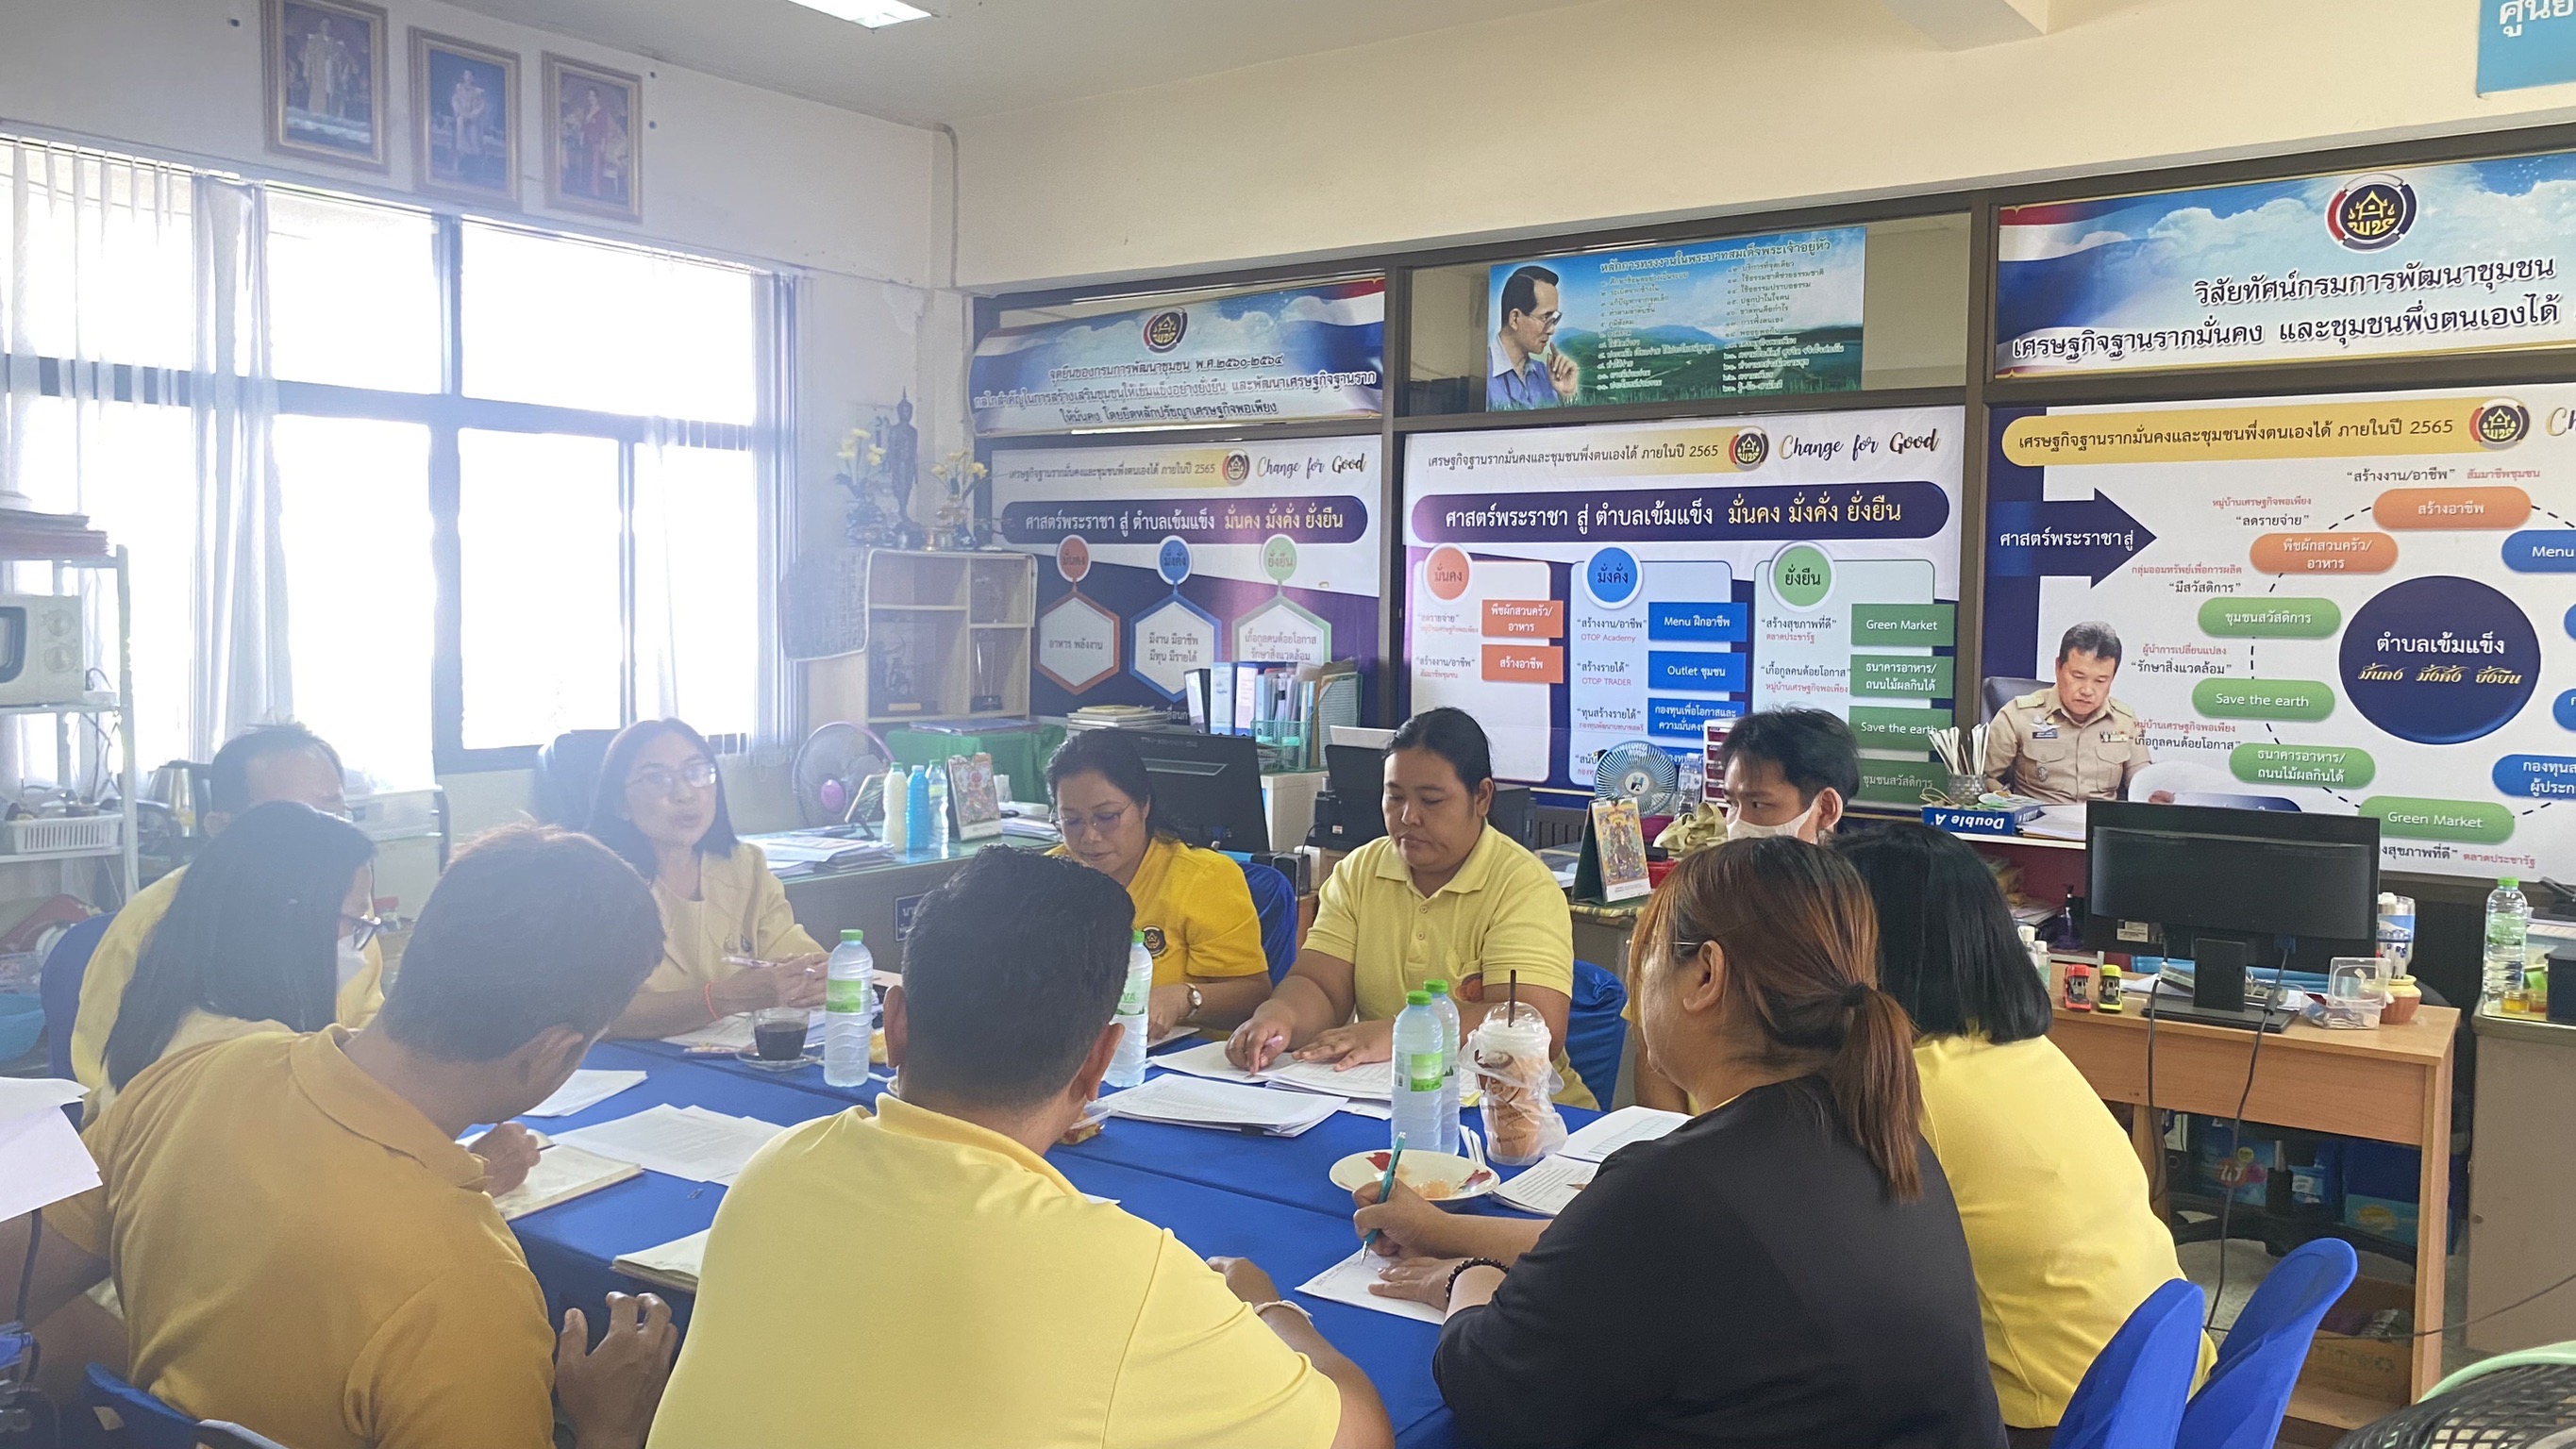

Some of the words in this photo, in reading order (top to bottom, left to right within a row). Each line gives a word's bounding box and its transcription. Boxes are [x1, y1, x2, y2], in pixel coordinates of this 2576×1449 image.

[1600, 238, 1831, 273] หลักการทรงงานในพระบาทสมเด็จพระเจ้าอยู่หัว
[2194, 258, 2555, 305] วิสัยทัศน์กรมการพัฒนาชุมชน
[2014, 318, 2264, 361] เศรษฐกิจฐานรากมั่นคง
[2279, 293, 2560, 349] และชุมชนพึ่งตนเองได้
[1231, 369, 1377, 392] และพัฒนาเศรษฐกิจฐานราก
[2017, 419, 2332, 453] เศรษฐกิจฐานรากมั่นคงและชุมชนพึ่งตนเองได้
[2337, 416, 2402, 438] ภายในปี
[2410, 418, 2453, 435] 2565
[1778, 437, 1844, 461] Change
[1852, 434, 1879, 461] for
[1889, 428, 1940, 455] Good
[1428, 443, 1638, 471] เศรษฐกิจฐานรากมั่นคงและชุมชนพึ่งตนเองได้
[1641, 442, 1686, 459] ภายในปี
[1689, 444, 1719, 458] 2565
[1194, 463, 1216, 475] 2565
[1257, 456, 1301, 479] Change
[1306, 457, 1325, 480] for
[1331, 452, 1366, 475] Good
[2347, 466, 2456, 483] “สร้างงาน/อาชีพ”
[1445, 503, 1569, 528] ศาสตร์พระราชา
[1577, 503, 1589, 535] สู่
[1596, 500, 1714, 528] ตำบลเข้มแข็ง
[1728, 496, 1781, 525] มั่นคง
[1788, 491, 1839, 523] มั่งคั่ง
[1848, 490, 1901, 522] ยั่งยืน
[2417, 500, 2484, 516] สร้างอาชีพ
[1025, 508, 1115, 531] ศาสตร์พระราชา
[1133, 507, 1215, 532] ตำบลเข้มแข็ง
[1223, 503, 1261, 530] มั่นคง
[1265, 502, 1300, 529] มั่งคั่ง
[1305, 502, 1344, 529] ยั่งยืน
[2235, 513, 2310, 526] “ลดรายจ่าย”
[2283, 537, 2372, 554] พืชผักสวนครัว/
[2532, 546, 2575, 558] Menu
[2307, 556, 2345, 570] อาหาร
[1434, 563, 1464, 583] มั่นคง
[1597, 563, 1629, 585] มั่งคั่ง
[1784, 564, 1821, 587] ยั่งยืน
[2168, 579, 2242, 594] “มีสวัสดิการ”
[1491, 602, 1553, 618] พืชผักสวนครัว/
[2225, 609, 2312, 627] ชุมชนสวัสดิการ
[1508, 622, 1535, 632] อาหาร
[1664, 616, 1692, 627] Menu
[1694, 614, 1731, 627] ฝึกอาชีพ
[1761, 614, 1837, 631] “สร้างสุขภาพที่ดี”
[1866, 619, 1898, 631] Green
[1900, 620, 1938, 631] Market
[1603, 634, 1636, 642] Academy
[2376, 632, 2505, 656] ตำบลเข้มแข็ง
[1499, 655, 1544, 670] สร้างอาชีพ
[1865, 661, 1936, 675] ธนาคารอาหาร/
[2131, 658, 2233, 675] “รักษาสิ่งแวดล้อม”
[1667, 664, 1698, 676] Outlet
[1700, 666, 1726, 680] ชุมชน
[1581, 677, 1602, 686] OTOP
[1604, 677, 1631, 686] TRADER
[1865, 677, 1936, 692] ถนนไม้ผลกินได้
[2216, 692, 2246, 705] Save
[2250, 693, 2271, 706] the
[2275, 695, 2309, 708] earth
[1654, 702, 1737, 719] กองทุนเพื่อโอกาสและ
[1861, 722, 1885, 734] Save
[1889, 722, 1907, 734] the
[1910, 724, 1938, 735] earth
[1575, 752, 1598, 765] “สนับ
[2257, 749, 2347, 764] ธนาคารอาหาร/
[2257, 765, 2345, 784] ถนนไม้ผลกินได้
[2531, 777, 2576, 798] ผู้ประก
[1935, 813, 1947, 826] A
[1950, 813, 2005, 830] Double
[2387, 812, 2430, 827] Green
[2434, 814, 2484, 829] Market
[2382, 843, 2458, 860] งสุขภาพที่ดี”
